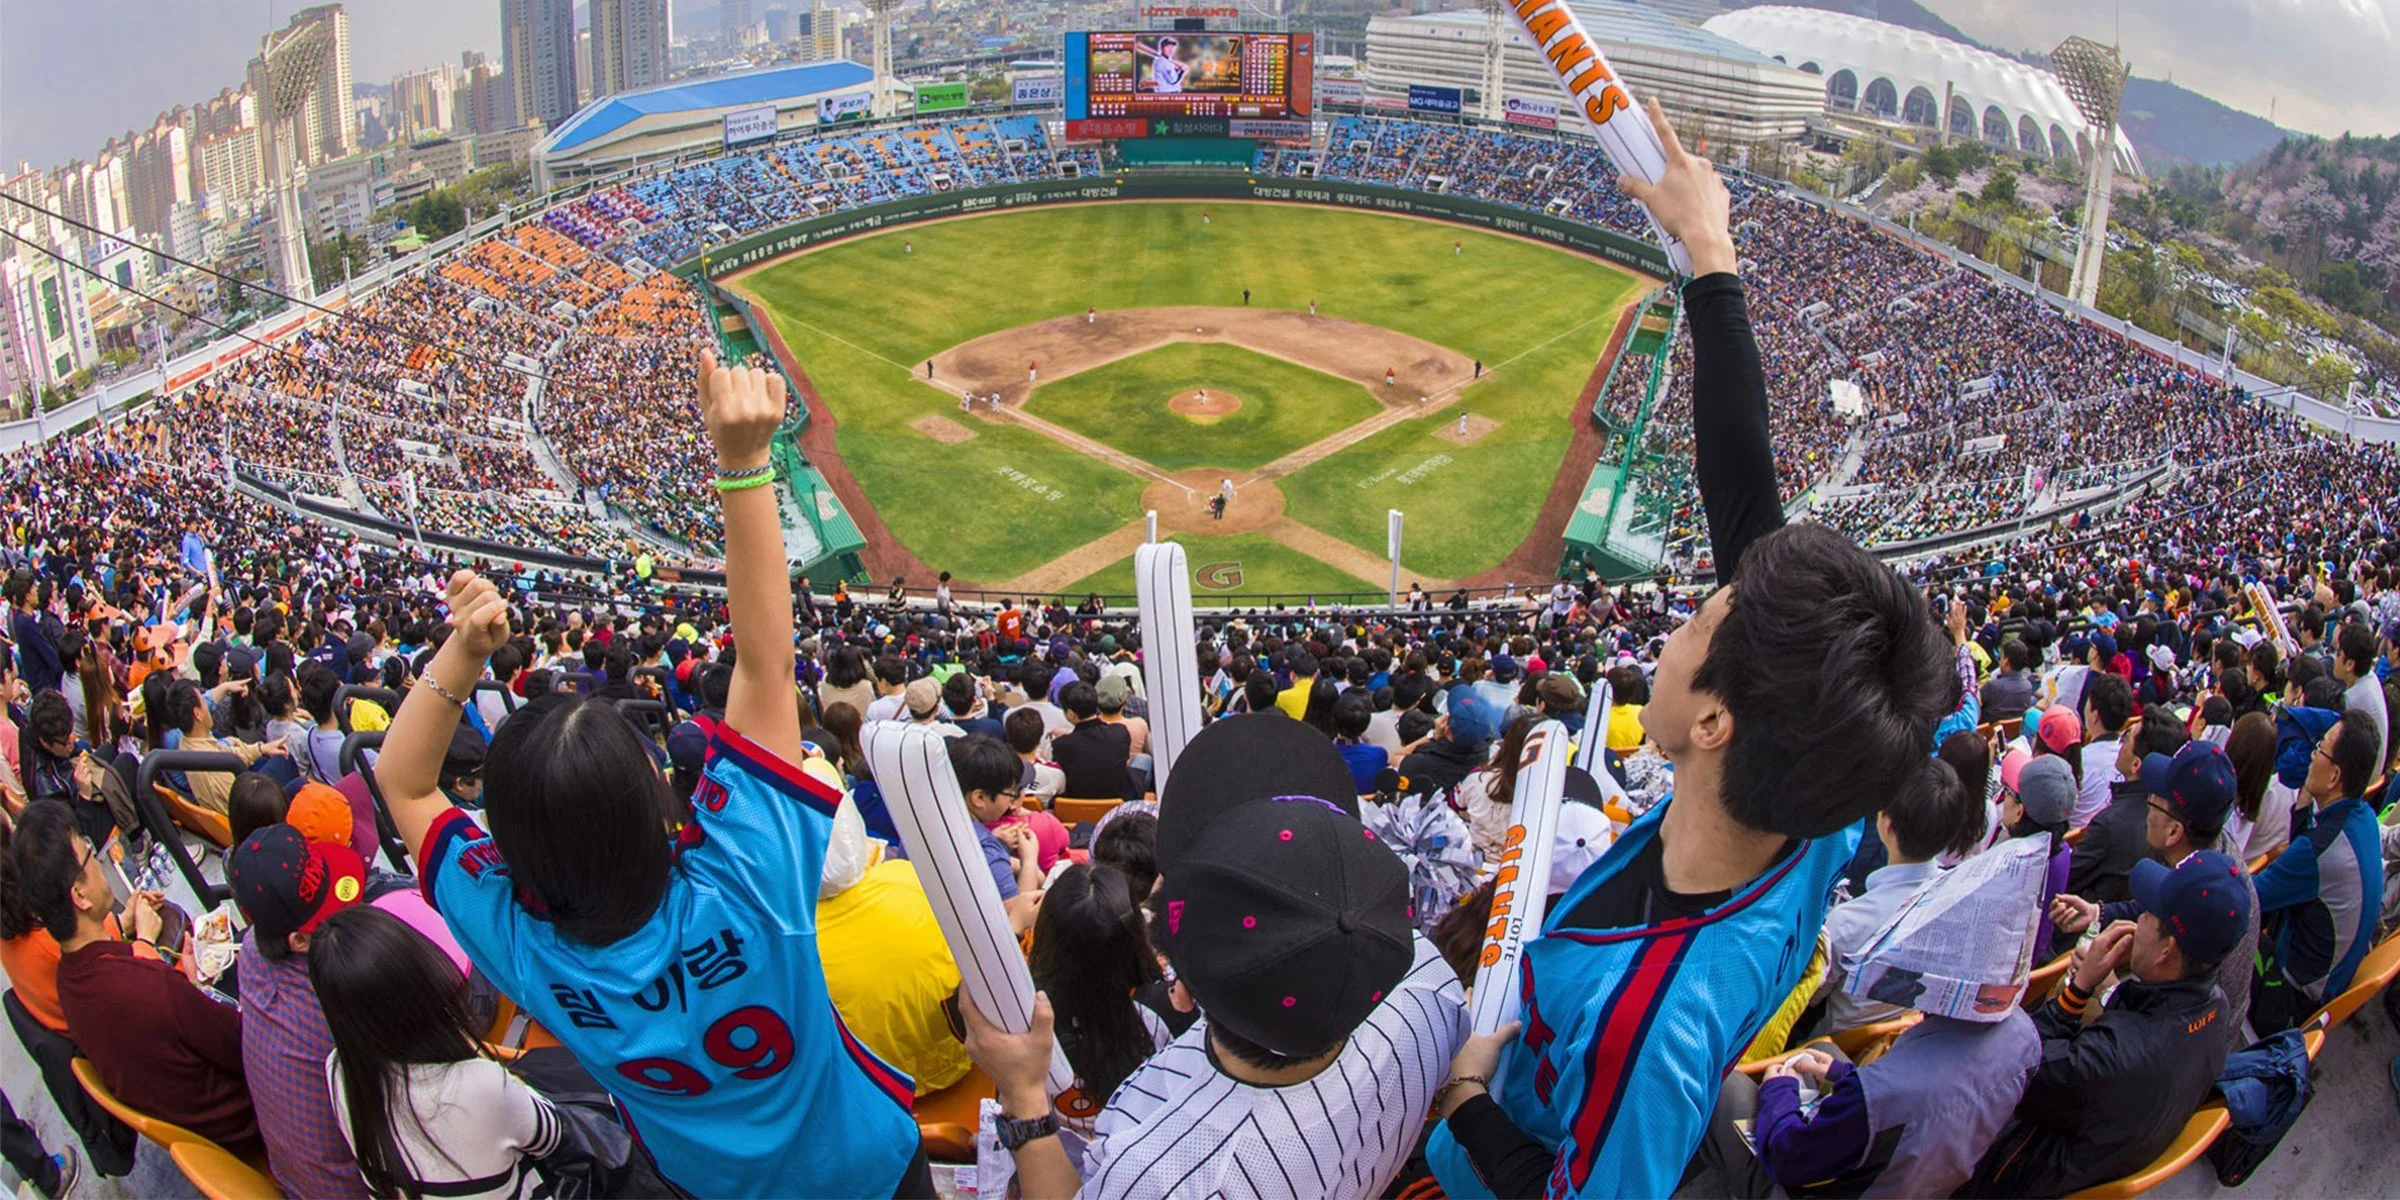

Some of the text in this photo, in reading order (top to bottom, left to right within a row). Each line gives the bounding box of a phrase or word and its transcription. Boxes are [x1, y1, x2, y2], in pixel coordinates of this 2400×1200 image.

[1140, 7, 1239, 18] LOTTE GIANTS
[1228, 39, 1240, 56] 7
[1508, 0, 1630, 126] IANTS
[1172, 121, 1225, 134] 칠성사이다
[1081, 187, 1118, 198] 대방건설
[1253, 186, 1291, 198] 대방건설
[1194, 561, 1244, 591] G
[1503, 917, 1524, 961] LOTTE
[615, 1004, 796, 1098] 99
